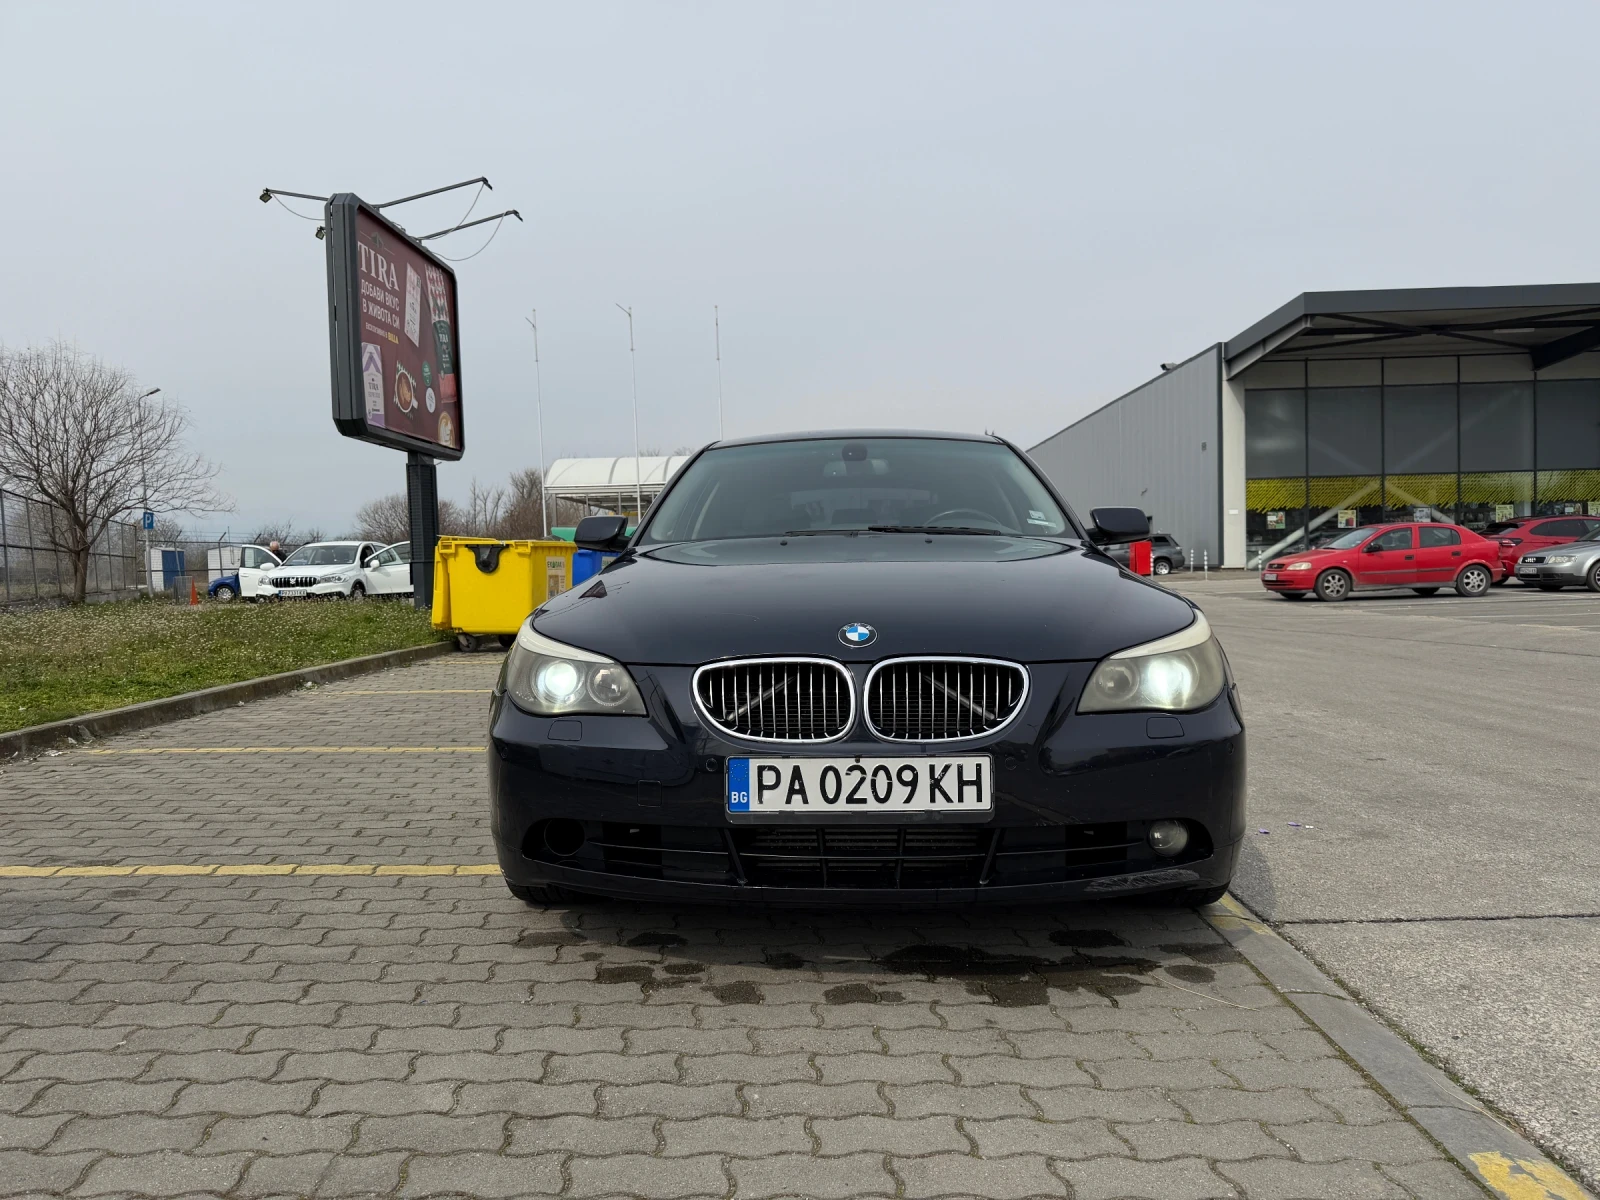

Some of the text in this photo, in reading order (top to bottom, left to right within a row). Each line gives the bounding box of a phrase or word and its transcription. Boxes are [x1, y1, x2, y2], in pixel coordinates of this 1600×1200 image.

[357, 241, 400, 291] TIRA
[361, 279, 400, 311] ДОБАВИ ВКУС
[362, 298, 368, 312] В
[368, 303, 392, 325] ЖИВОТА
[392, 315, 400, 330] СИ
[145, 513, 152, 527] P
[731, 791, 748, 803] BG
